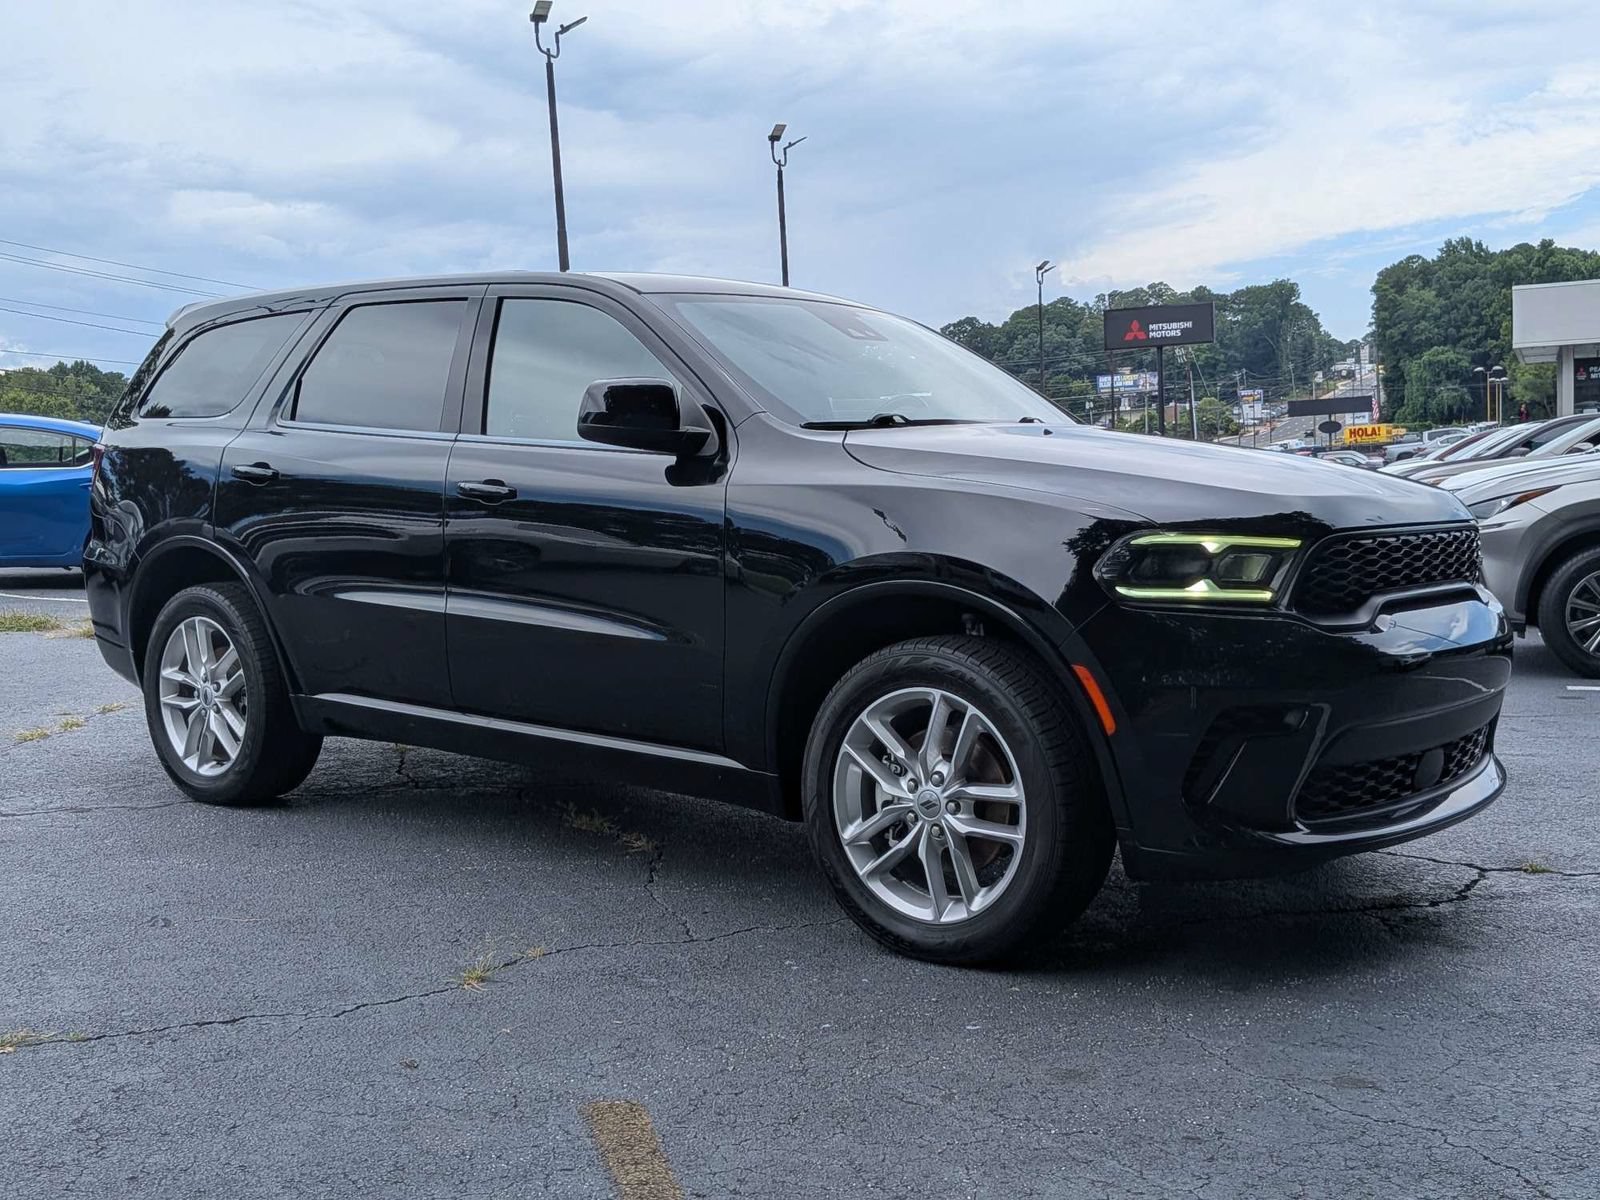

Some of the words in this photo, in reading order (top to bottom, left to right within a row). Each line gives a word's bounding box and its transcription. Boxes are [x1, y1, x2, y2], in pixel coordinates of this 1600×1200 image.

[1149, 321, 1192, 330] MITSUBISHI
[1149, 329, 1182, 338] MOTORS
[1349, 426, 1381, 438] HOLA!
